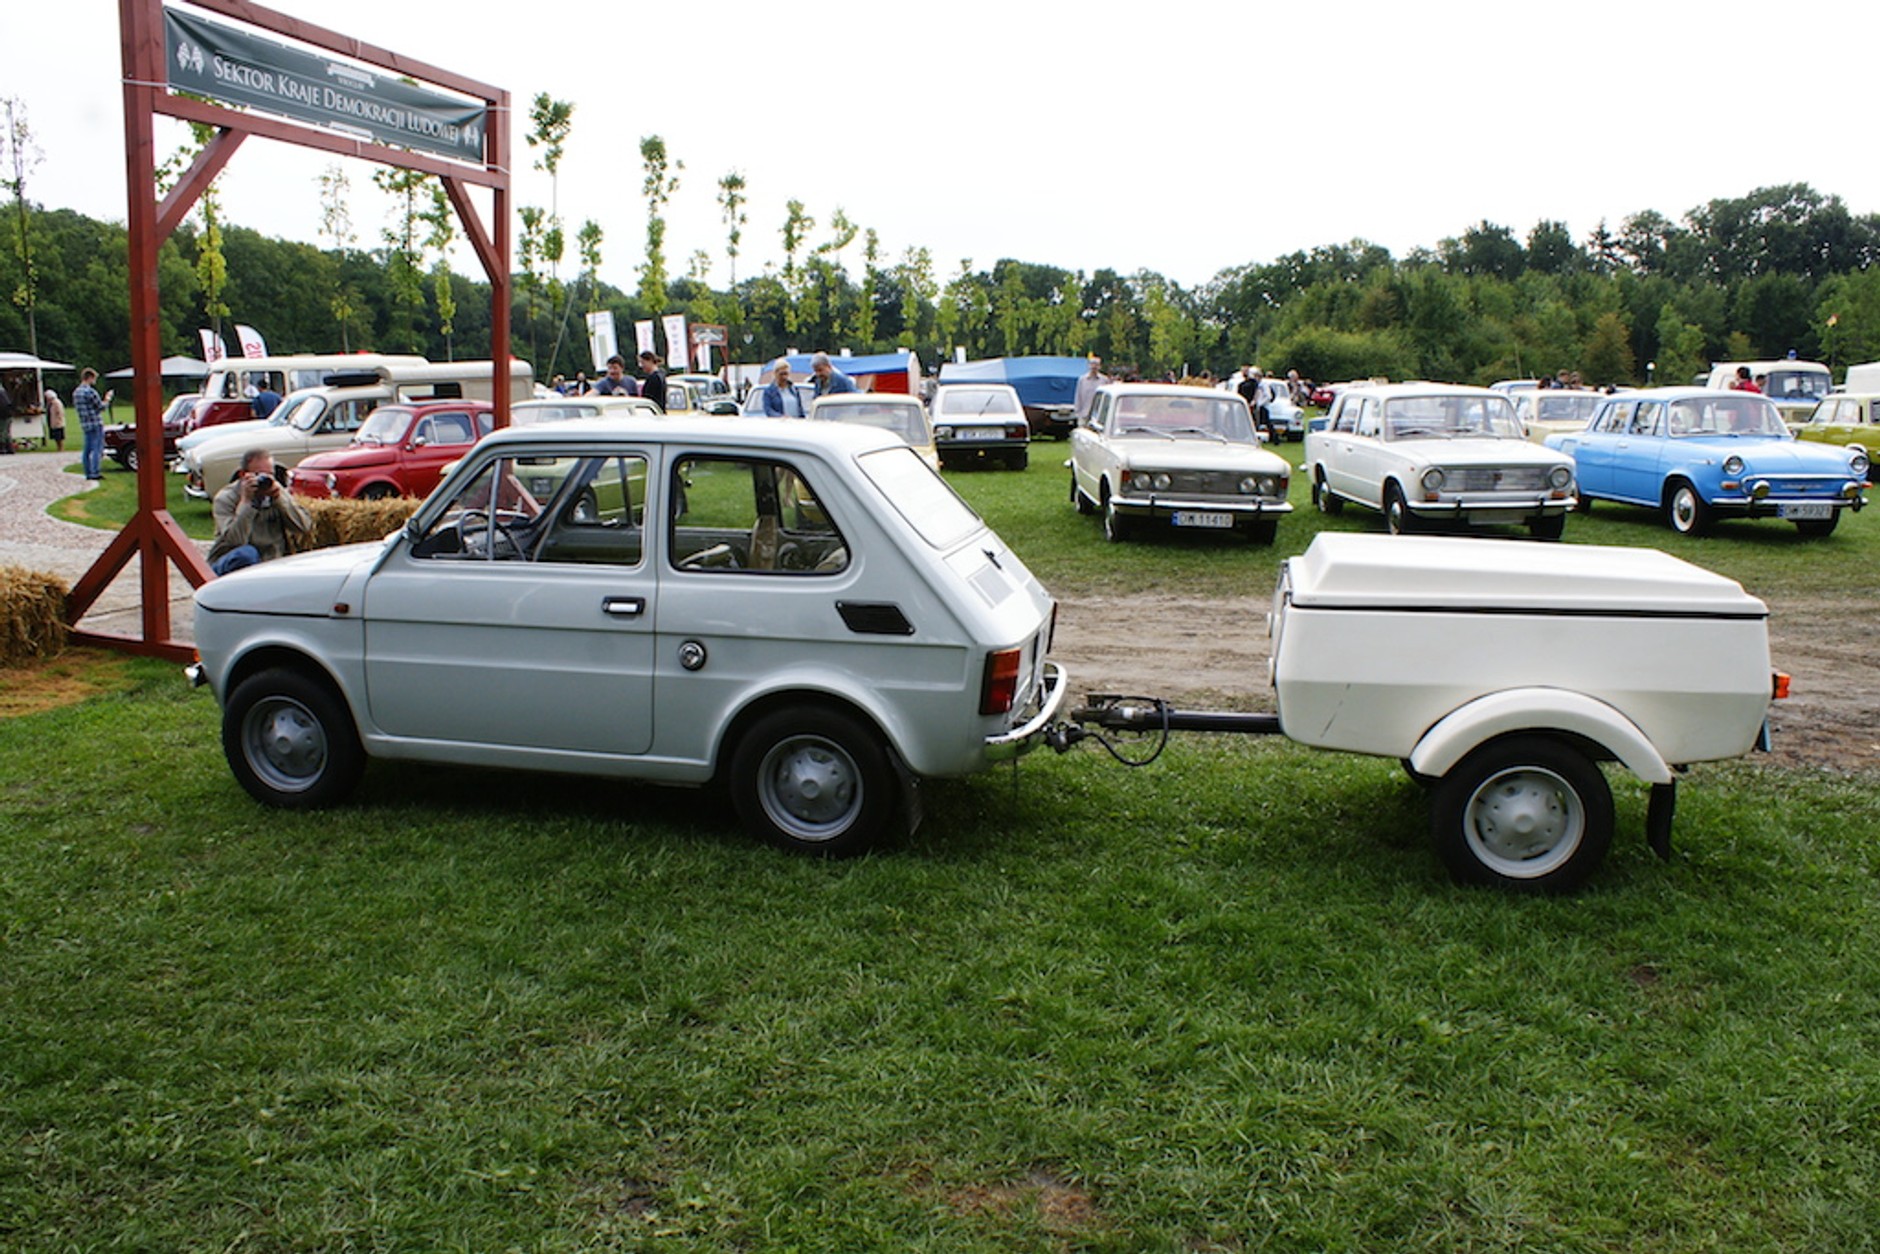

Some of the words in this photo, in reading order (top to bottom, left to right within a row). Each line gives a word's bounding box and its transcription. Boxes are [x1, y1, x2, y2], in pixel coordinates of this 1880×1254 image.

[213, 55, 276, 93] SEKTOR
[278, 74, 321, 106] KRAJE
[323, 88, 406, 129] DEMOKRACJI
